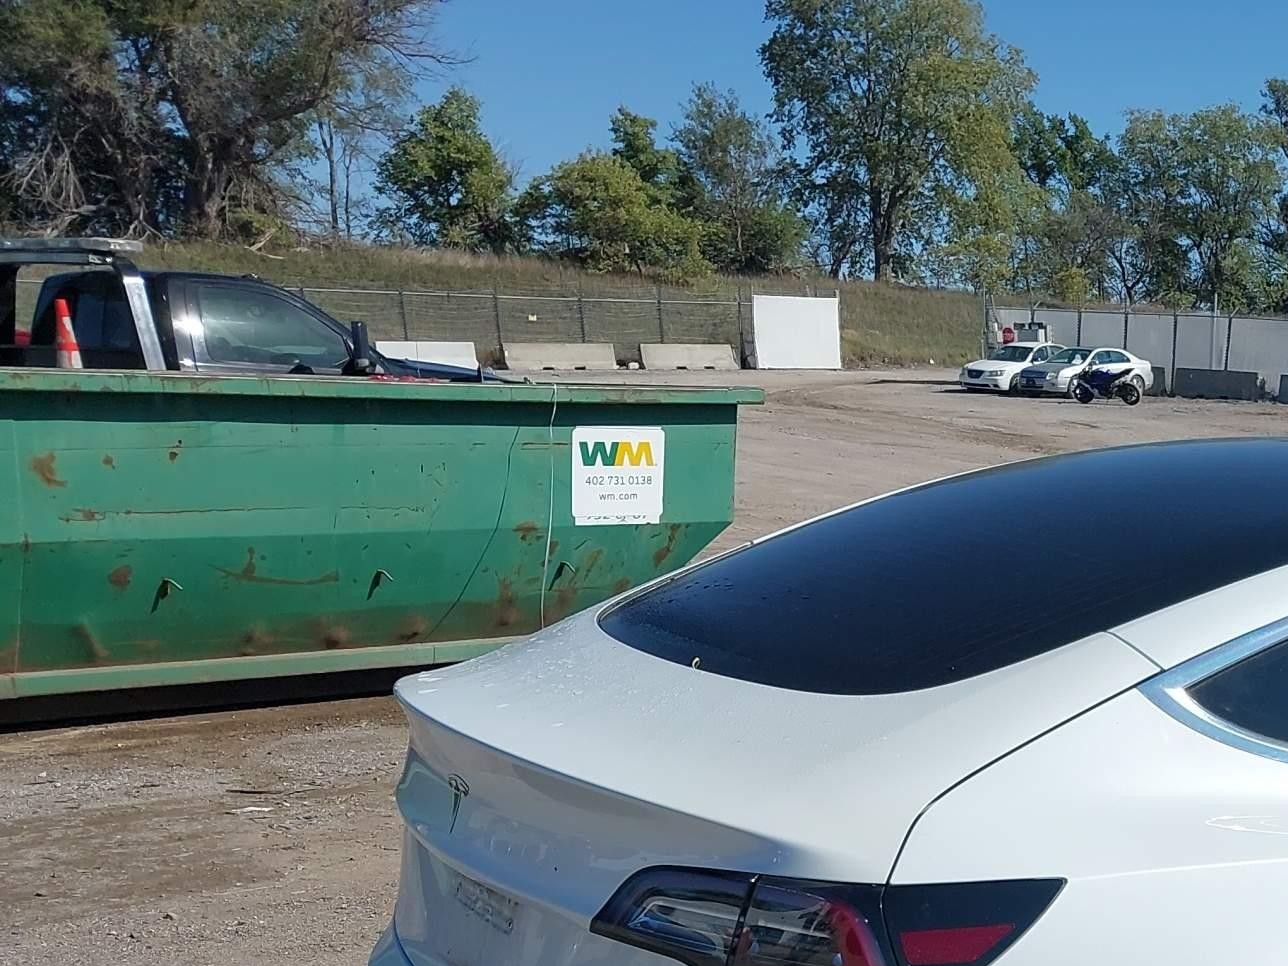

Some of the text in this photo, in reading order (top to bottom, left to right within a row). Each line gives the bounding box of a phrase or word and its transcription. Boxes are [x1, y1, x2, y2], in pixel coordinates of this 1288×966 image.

[579, 441, 655, 466] WM
[585, 476, 652, 485] 402 731 0138
[599, 493, 638, 501] wm.com
